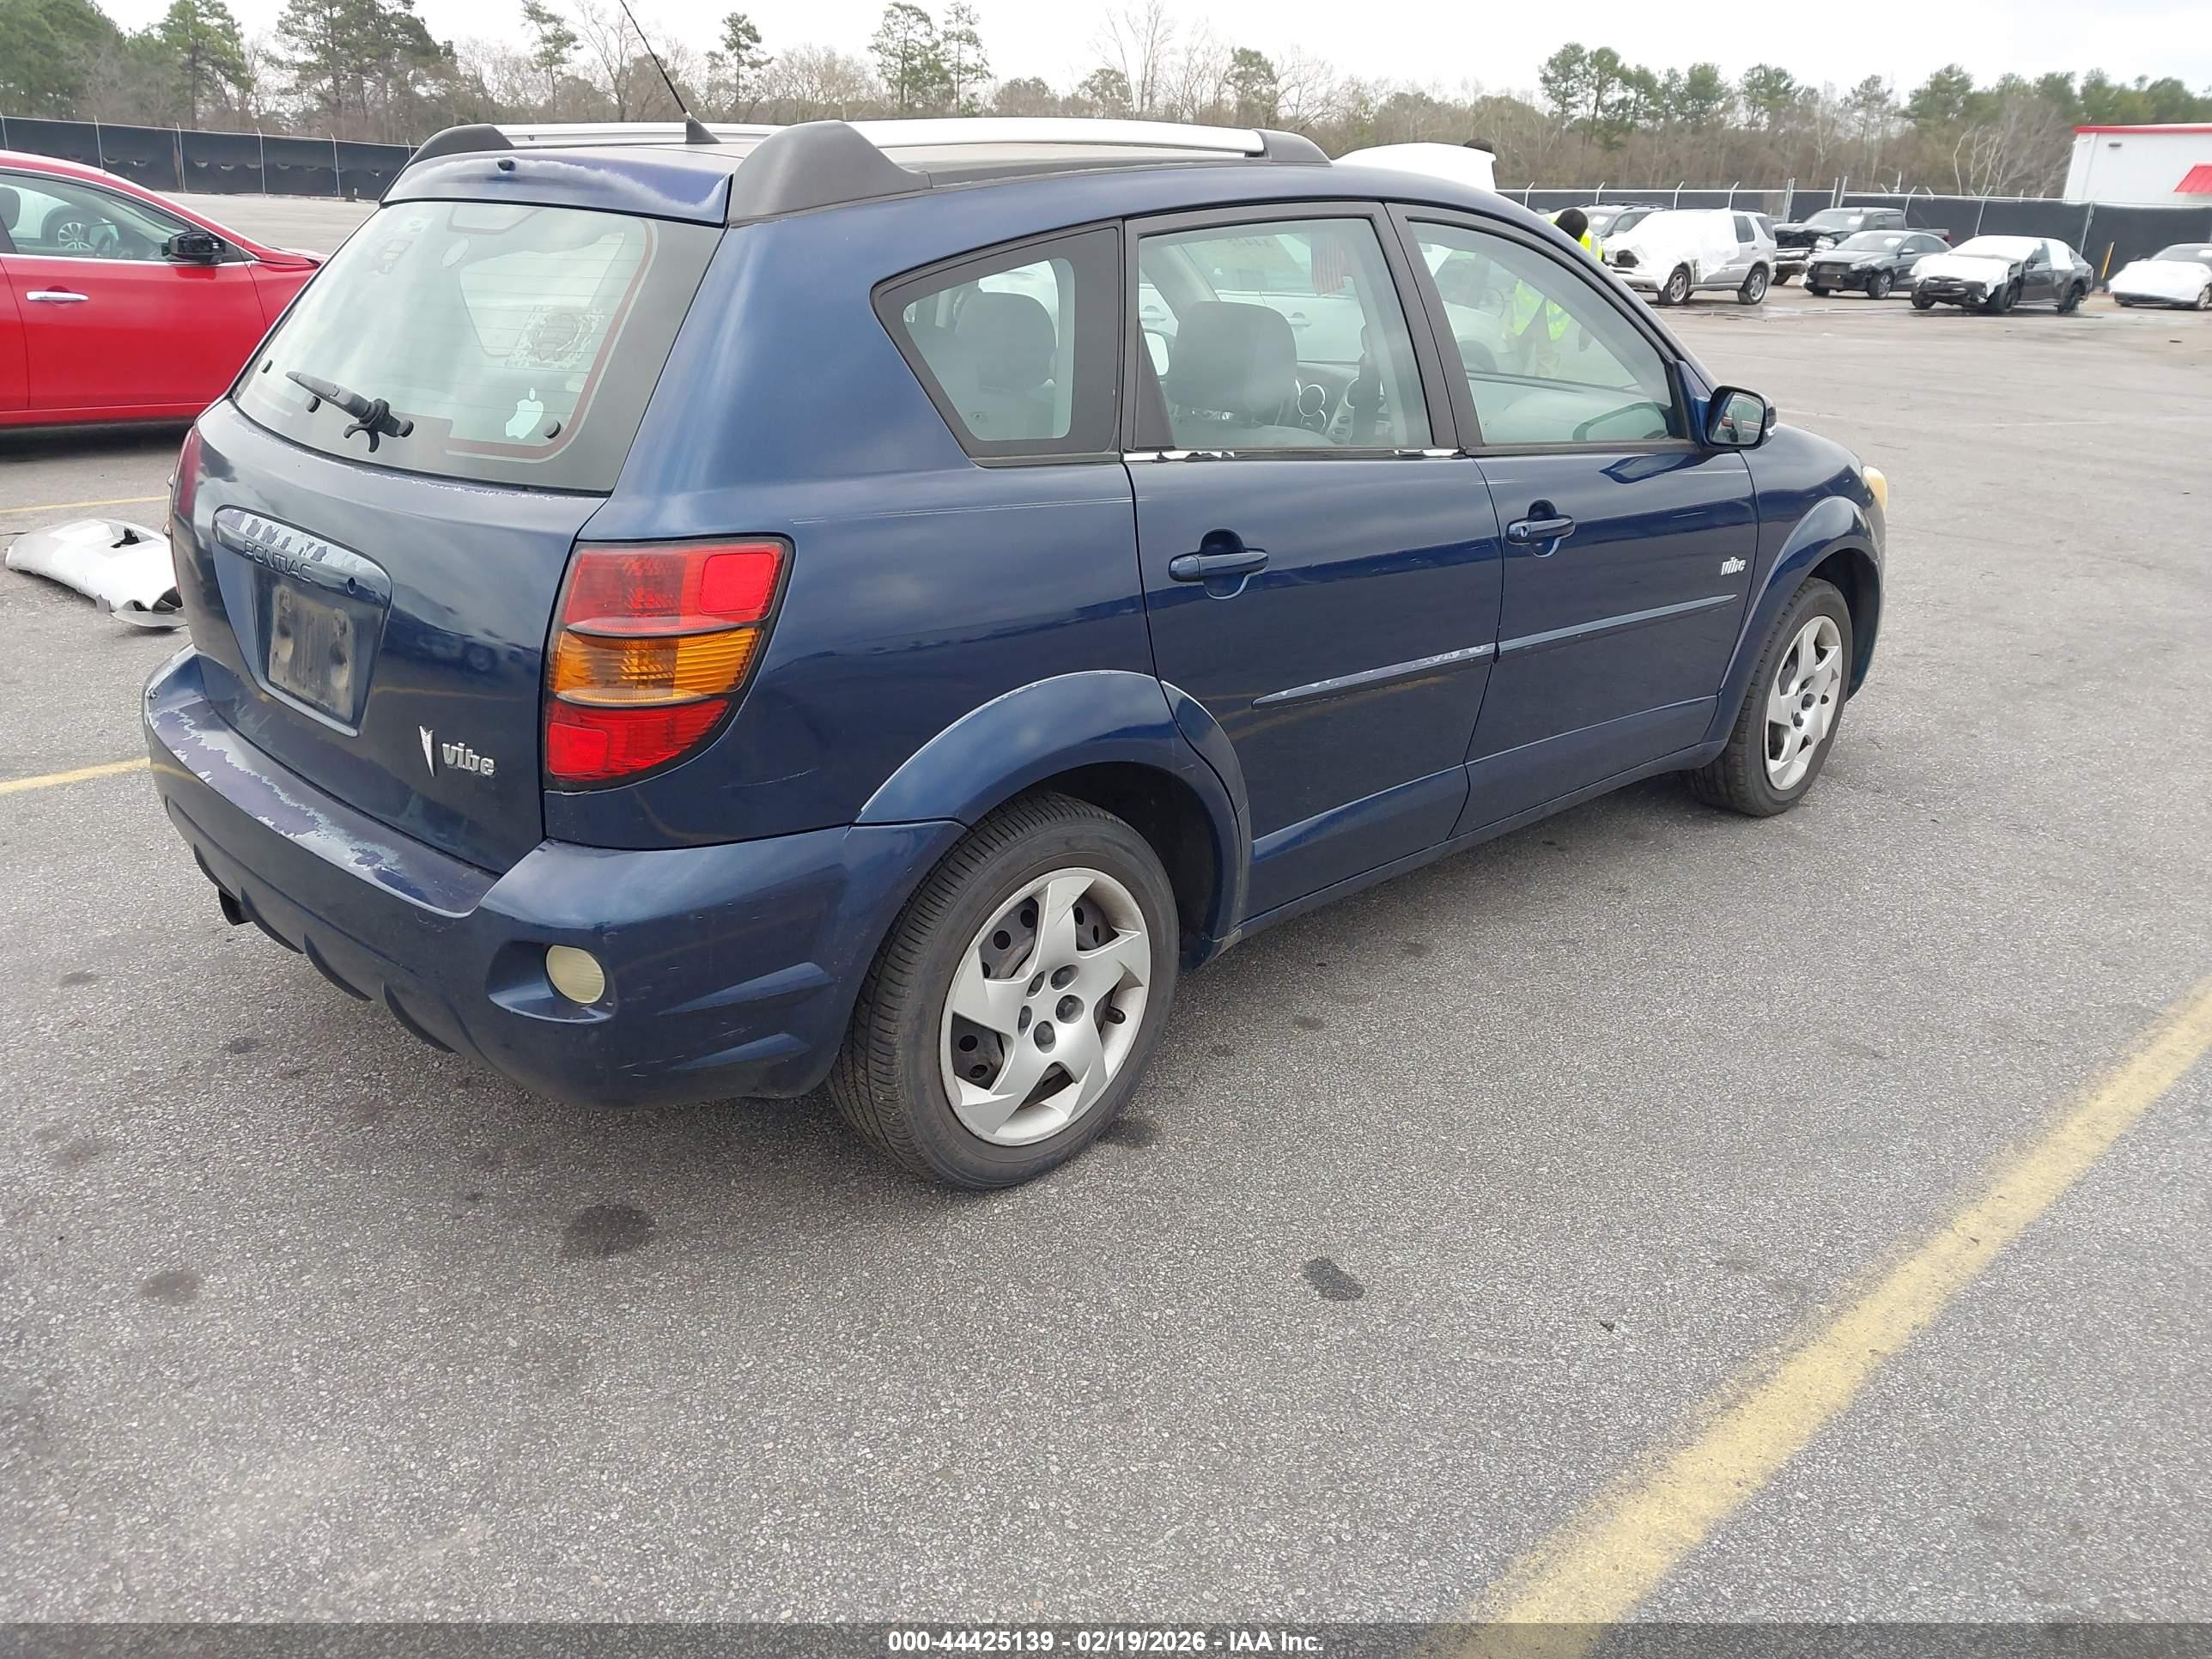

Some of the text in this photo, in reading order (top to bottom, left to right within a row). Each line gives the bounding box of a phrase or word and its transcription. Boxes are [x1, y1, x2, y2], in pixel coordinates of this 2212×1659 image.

[244, 539, 312, 583] PONTIAC
[1721, 556, 1747, 575] vibe
[441, 742, 495, 776] vibe
